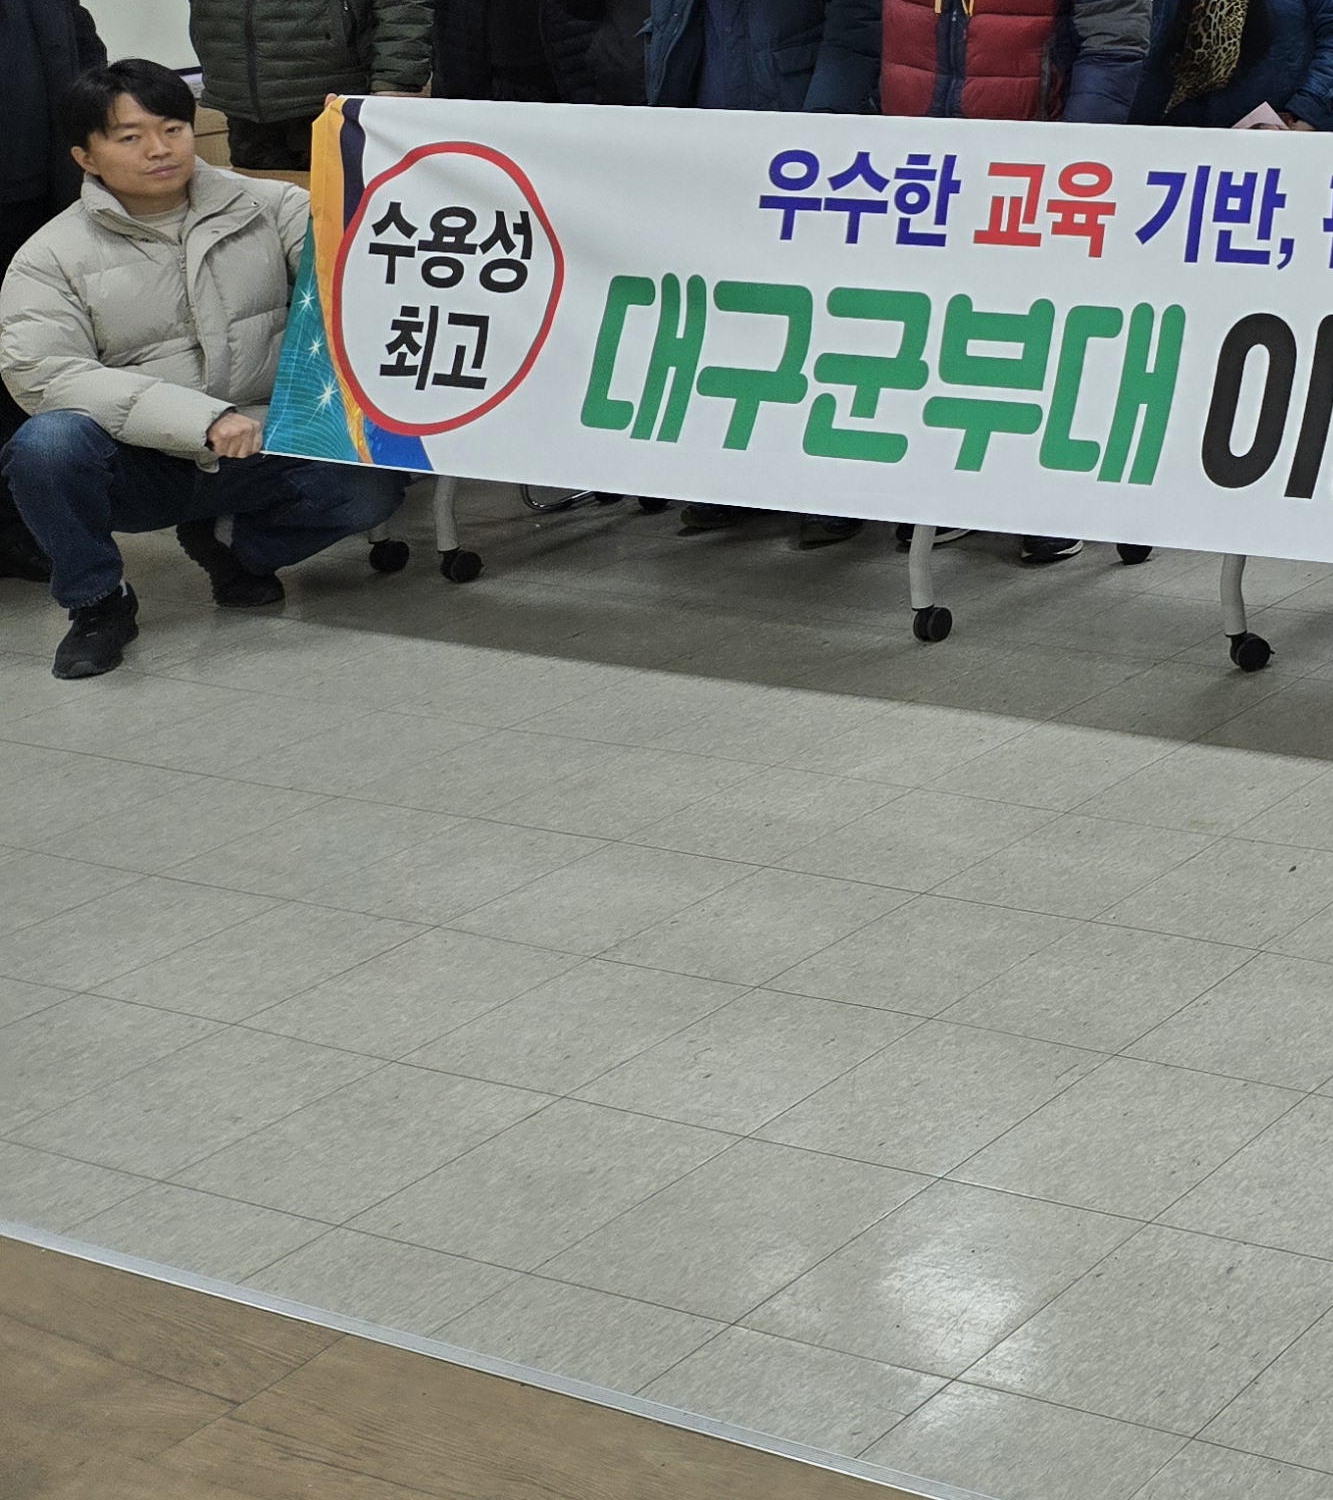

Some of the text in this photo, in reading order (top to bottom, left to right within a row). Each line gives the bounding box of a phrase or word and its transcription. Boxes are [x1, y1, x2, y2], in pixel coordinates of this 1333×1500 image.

[368, 201, 533, 294] 수용성
[758, 149, 962, 247] 우수한
[973, 162, 1116, 258] 교육
[1135, 165, 1295, 270] 기반,
[379, 305, 490, 391] 최고
[580, 272, 1186, 485] 대구군부대
